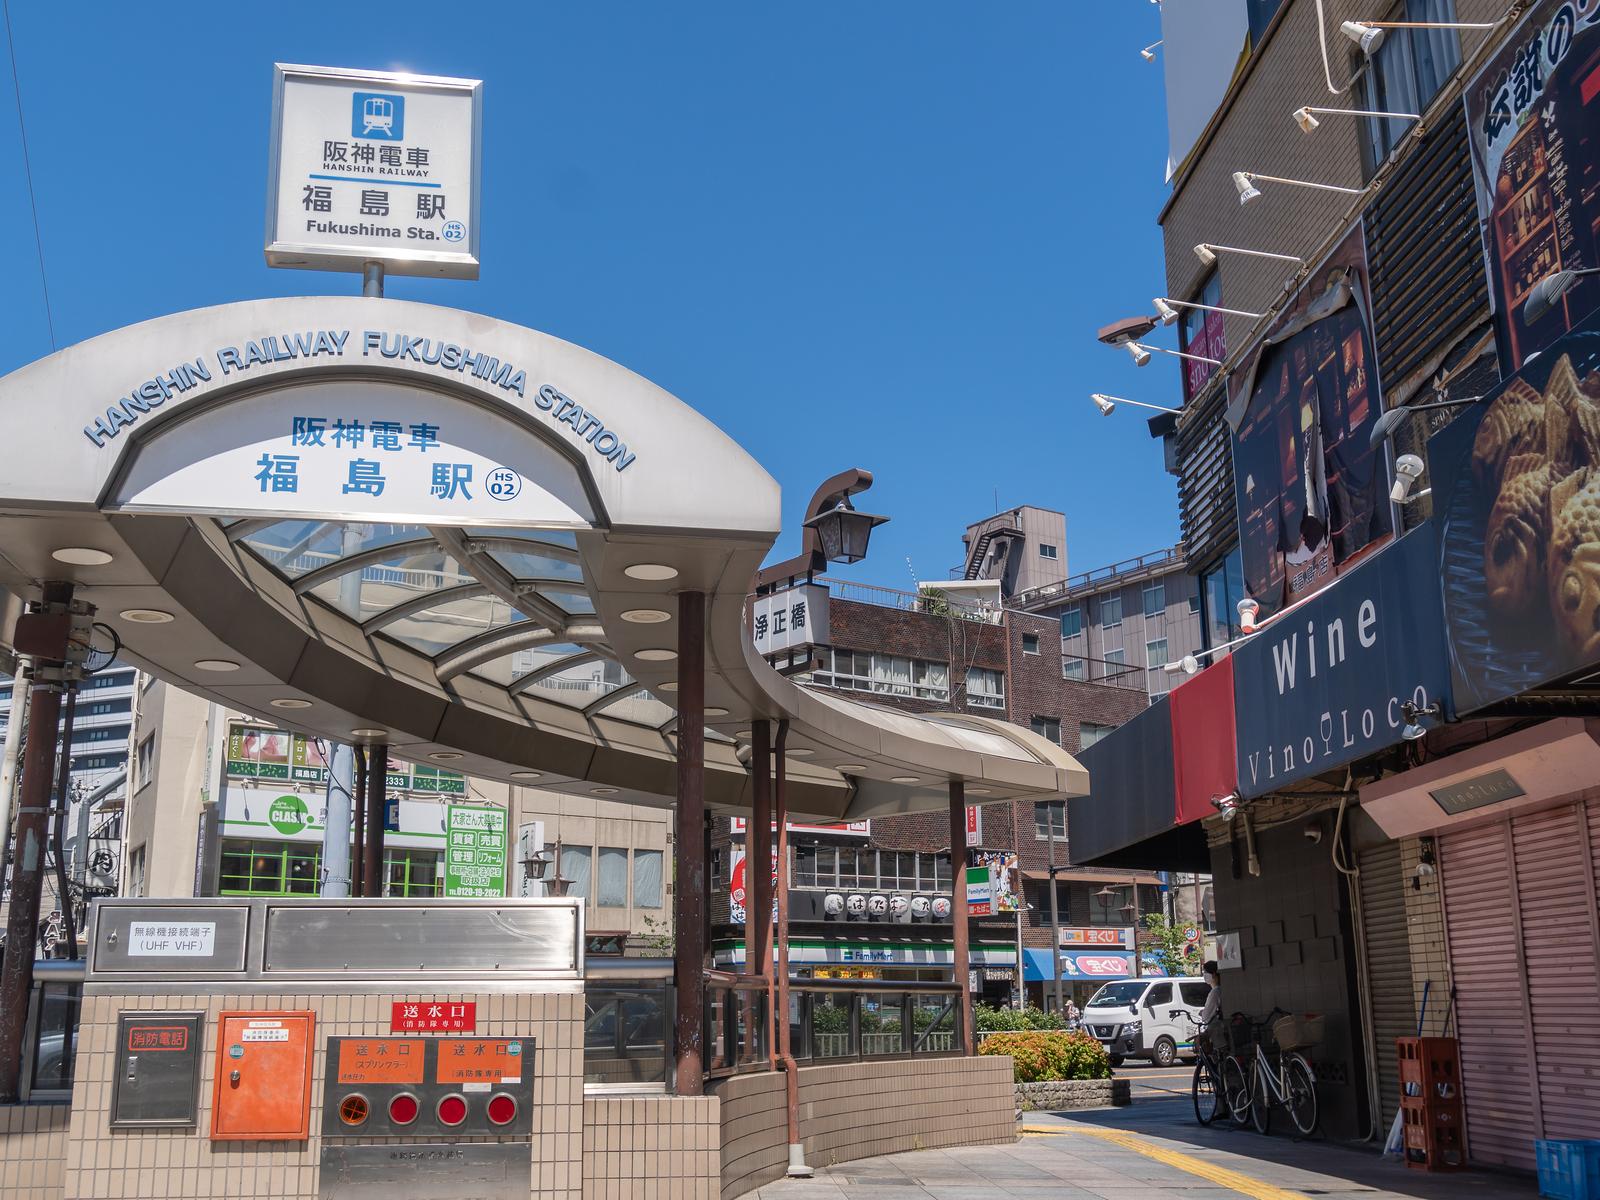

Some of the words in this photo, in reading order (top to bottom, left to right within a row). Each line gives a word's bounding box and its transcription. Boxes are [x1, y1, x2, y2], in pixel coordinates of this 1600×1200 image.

[323, 140, 430, 169] 阪神電車
[323, 163, 374, 173] HANSHIN
[379, 168, 429, 177] RAILWAY
[302, 185, 446, 220] 福島駅
[306, 220, 401, 238] Fukushima
[406, 227, 440, 241] Sta.
[445, 230, 462, 239] 02
[83, 357, 212, 448] HANSHIN
[217, 330, 351, 374] RAILWAY
[362, 330, 528, 396] FUKUSHIMA
[534, 383, 636, 472] STATION
[292, 416, 441, 452] 阪神電車
[254, 453, 473, 501] 福島駅
[494, 472, 514, 482] HS
[490, 482, 516, 496] 02
[754, 602, 806, 641] 浄正橋
[1272, 599, 1377, 695] Wine
[1248, 736, 1314, 786] Vino
[453, 832, 474, 845] 賃貸
[480, 835, 501, 847] 売買
[452, 851, 474, 862] 管理
[479, 852, 502, 864] リフォーム
[134, 926, 212, 939] 無線機接続端子
[855, 951, 893, 961] FamilyMart
[403, 1005, 465, 1018] 送水口
[132, 1031, 184, 1046] 消防電話
[355, 1043, 410, 1056] 送水口
[453, 1043, 507, 1056] 送水口
